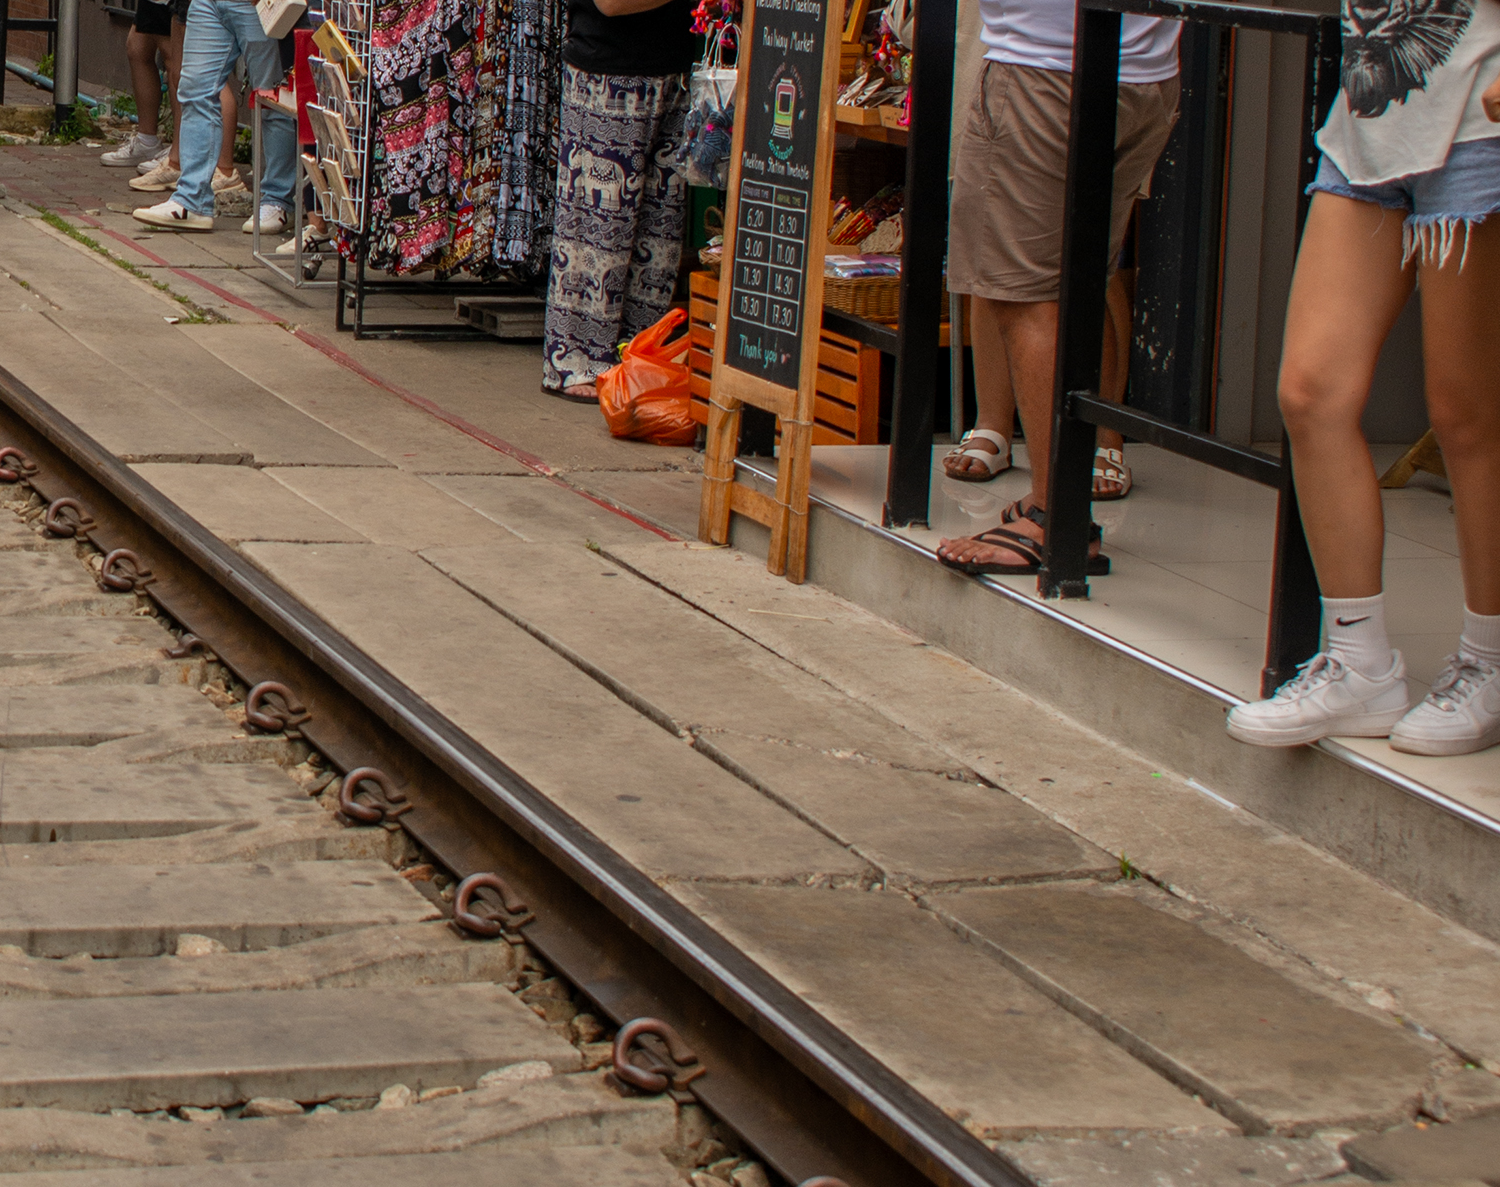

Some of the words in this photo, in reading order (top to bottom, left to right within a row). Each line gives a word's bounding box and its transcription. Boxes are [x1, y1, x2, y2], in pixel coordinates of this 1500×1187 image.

[762, 25, 788, 56] Railway
[789, 30, 815, 53] Market
[767, 156, 785, 175] Station
[746, 207, 764, 227] 6.20
[778, 214, 797, 234] 8.30
[744, 237, 763, 258] 9.00
[776, 243, 796, 265] 11.00
[742, 266, 761, 286] 11.30
[774, 273, 793, 295] 14.30
[740, 295, 759, 317] 15.30
[772, 304, 792, 327] 17.30
[739, 334, 762, 360] Thank
[763, 348, 778, 369] you
